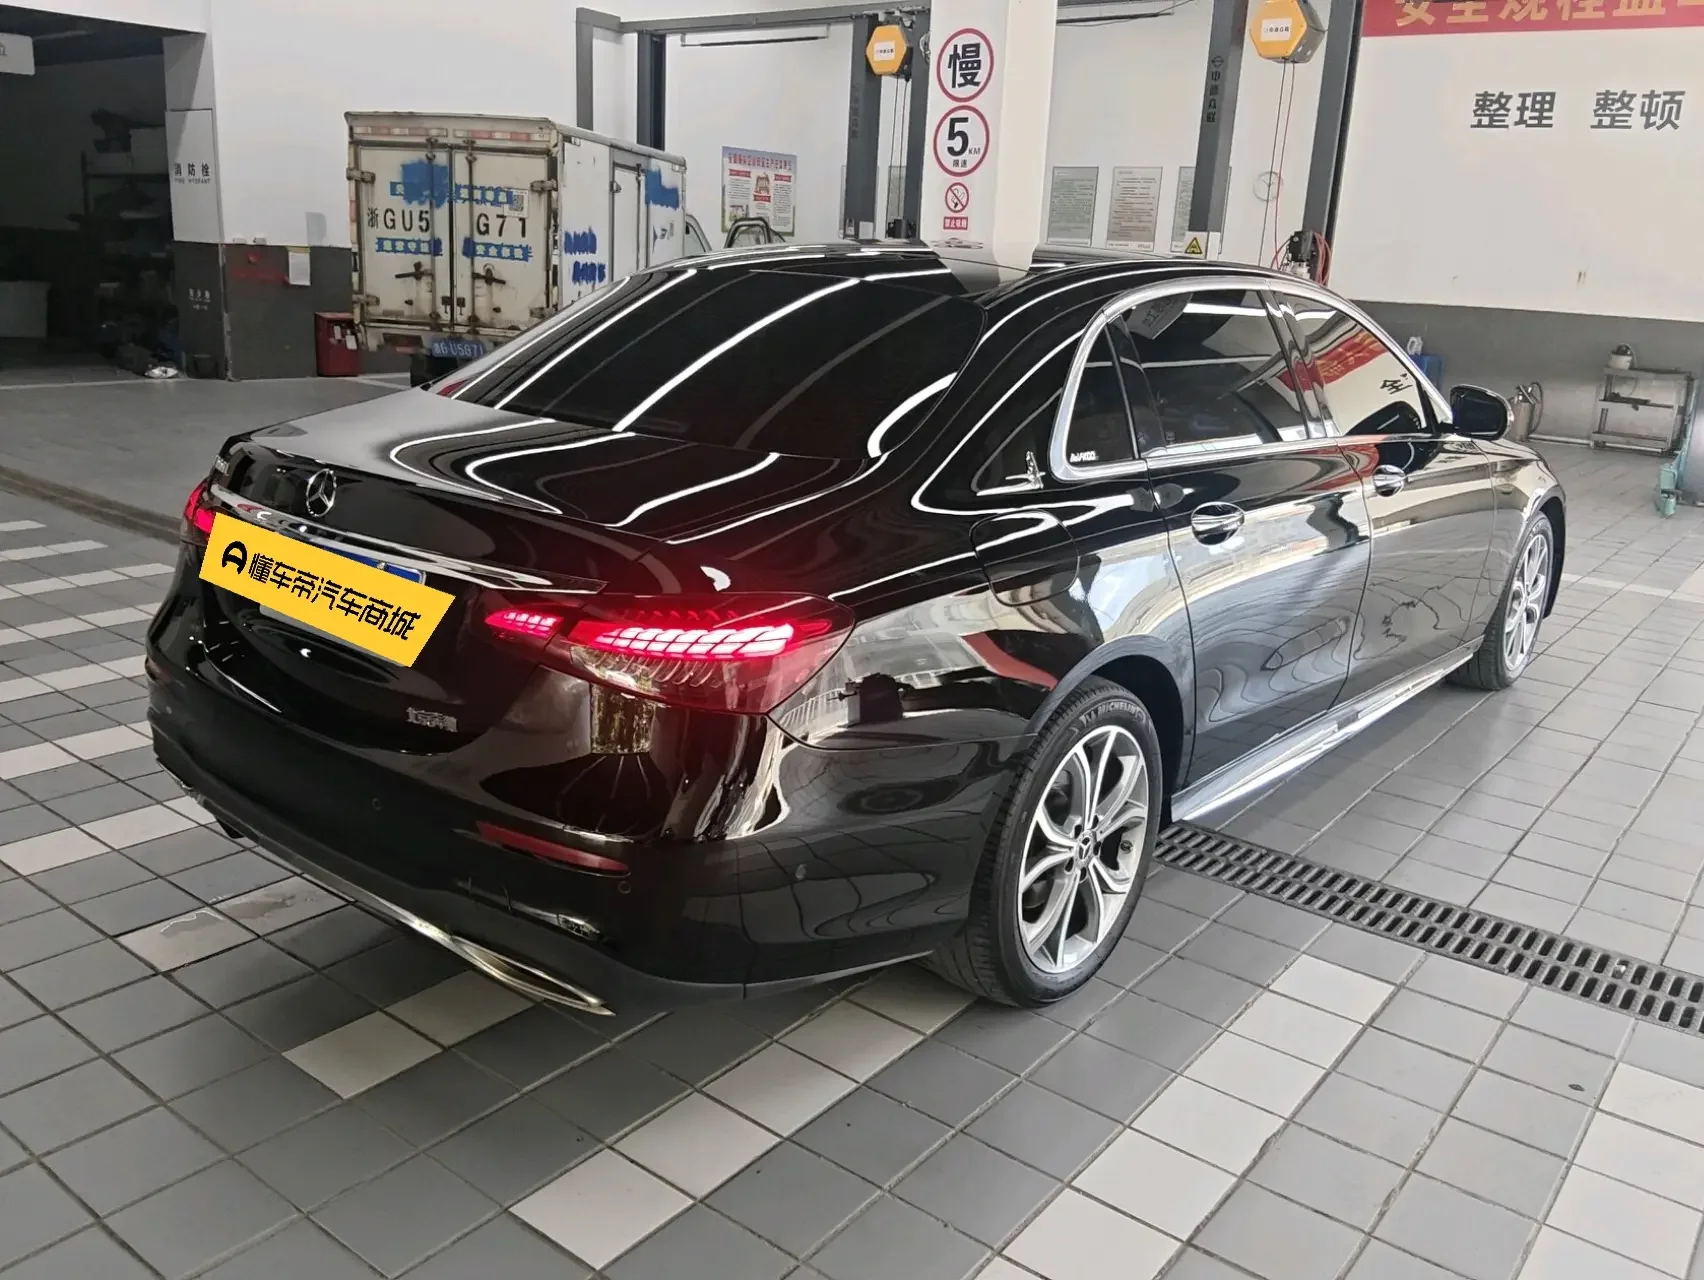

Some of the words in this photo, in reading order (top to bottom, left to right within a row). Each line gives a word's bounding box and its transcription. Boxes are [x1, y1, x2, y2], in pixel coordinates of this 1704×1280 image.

[947, 42, 982, 89] 慢
[1470, 91, 1556, 129] 整理
[1590, 89, 1686, 131] 整顿
[946, 117, 970, 157] 5
[952, 159, 968, 168] 限速
